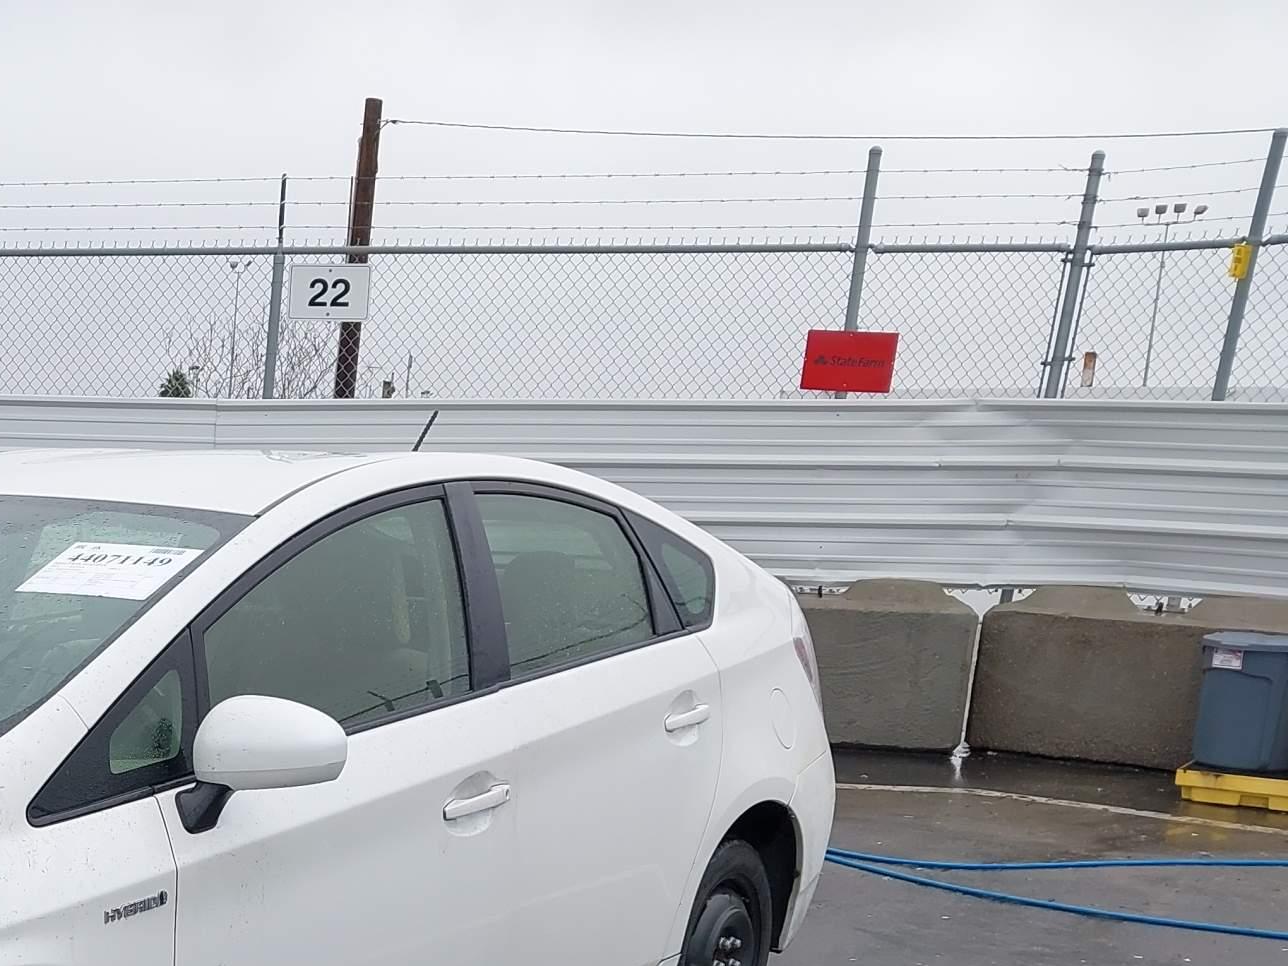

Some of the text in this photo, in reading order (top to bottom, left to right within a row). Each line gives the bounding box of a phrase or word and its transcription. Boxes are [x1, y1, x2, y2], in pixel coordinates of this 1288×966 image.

[308, 278, 351, 307] 22
[68, 553, 173, 567] 44071149
[103, 896, 159, 925] HYBRID
